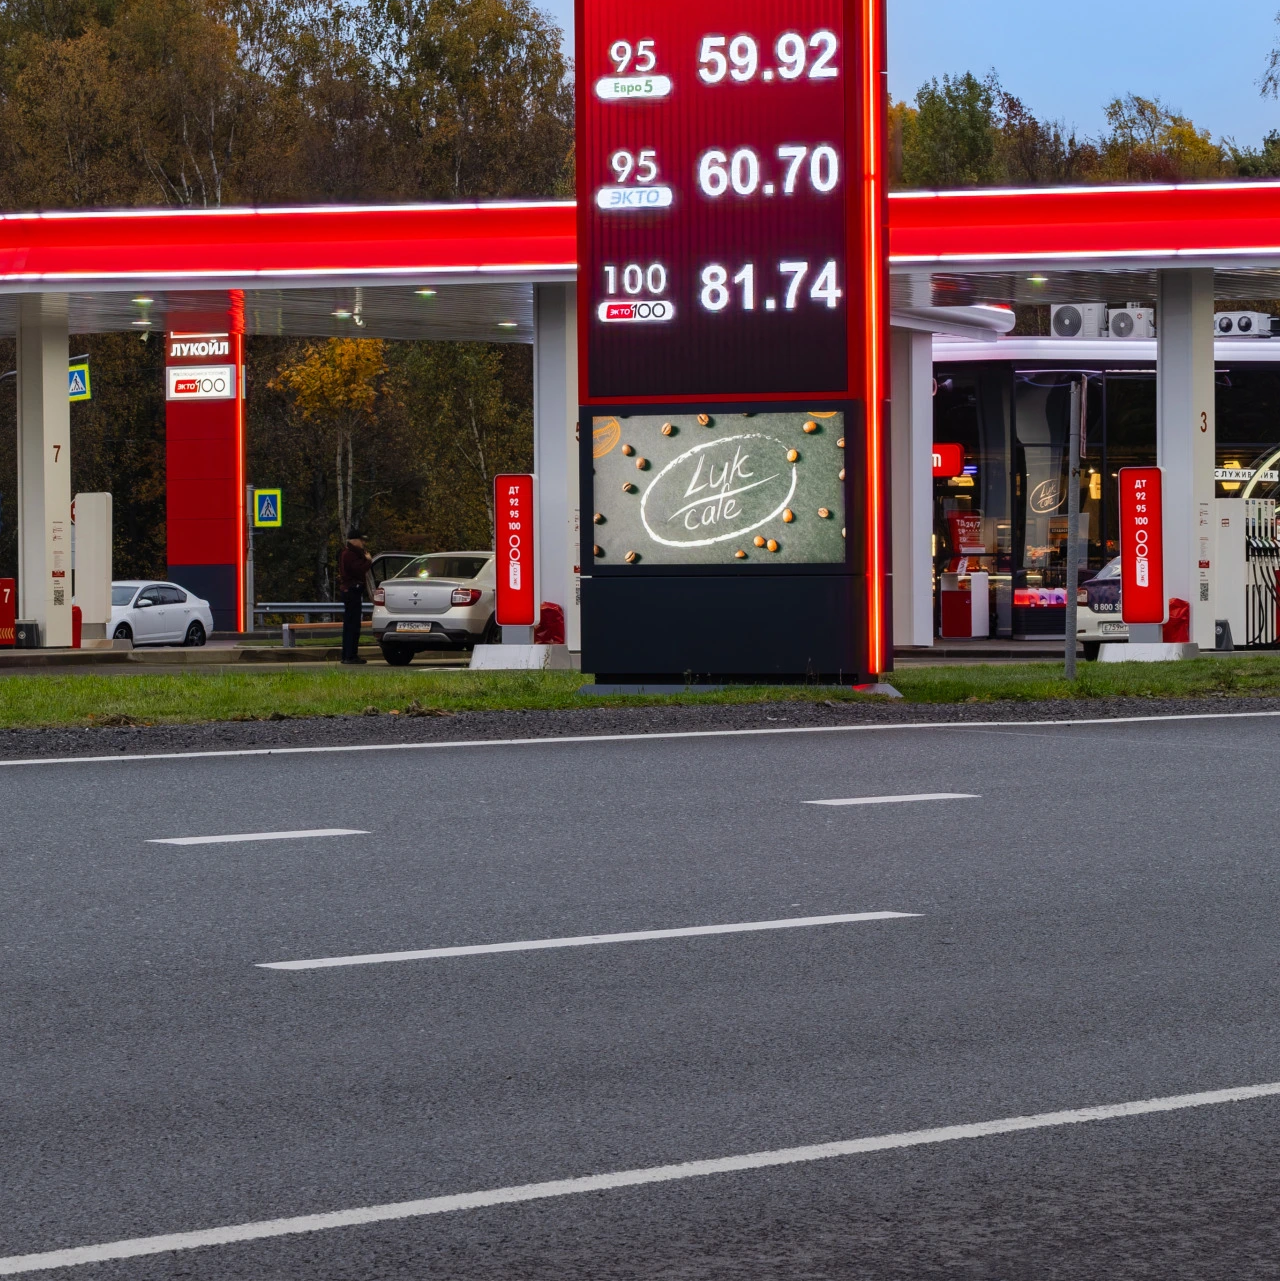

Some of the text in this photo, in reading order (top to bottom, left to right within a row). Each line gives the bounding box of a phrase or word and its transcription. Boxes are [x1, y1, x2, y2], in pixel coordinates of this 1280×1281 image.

[610, 31, 838, 83] 95 59.92
[614, 80, 653, 96] Евро 5
[611, 145, 839, 196] 95 60.70
[610, 190, 659, 205] ЭКТО
[604, 260, 841, 311] 100 81.74
[170, 339, 229, 357] ЛУКОЙЛ
[1200, 411, 1207, 433] 3
[53, 444, 61, 463] 7
[683, 445, 754, 498] Luk
[508, 486, 519, 495] ДТ
[1134, 480, 1147, 489] ДТ
[509, 498, 519, 506] 92
[1135, 492, 1146, 500] 92
[684, 482, 742, 530] cafe
[1136, 504, 1146, 512] 95
[510, 510, 519, 518] 95
[1134, 517, 1148, 525] 100
[508, 522, 521, 530] 100
[965, 521, 981, 529] 24/7
[3, 588, 11, 603] 7
[1094, 603, 1099, 611] 8
[1100, 603, 1113, 611] 800
